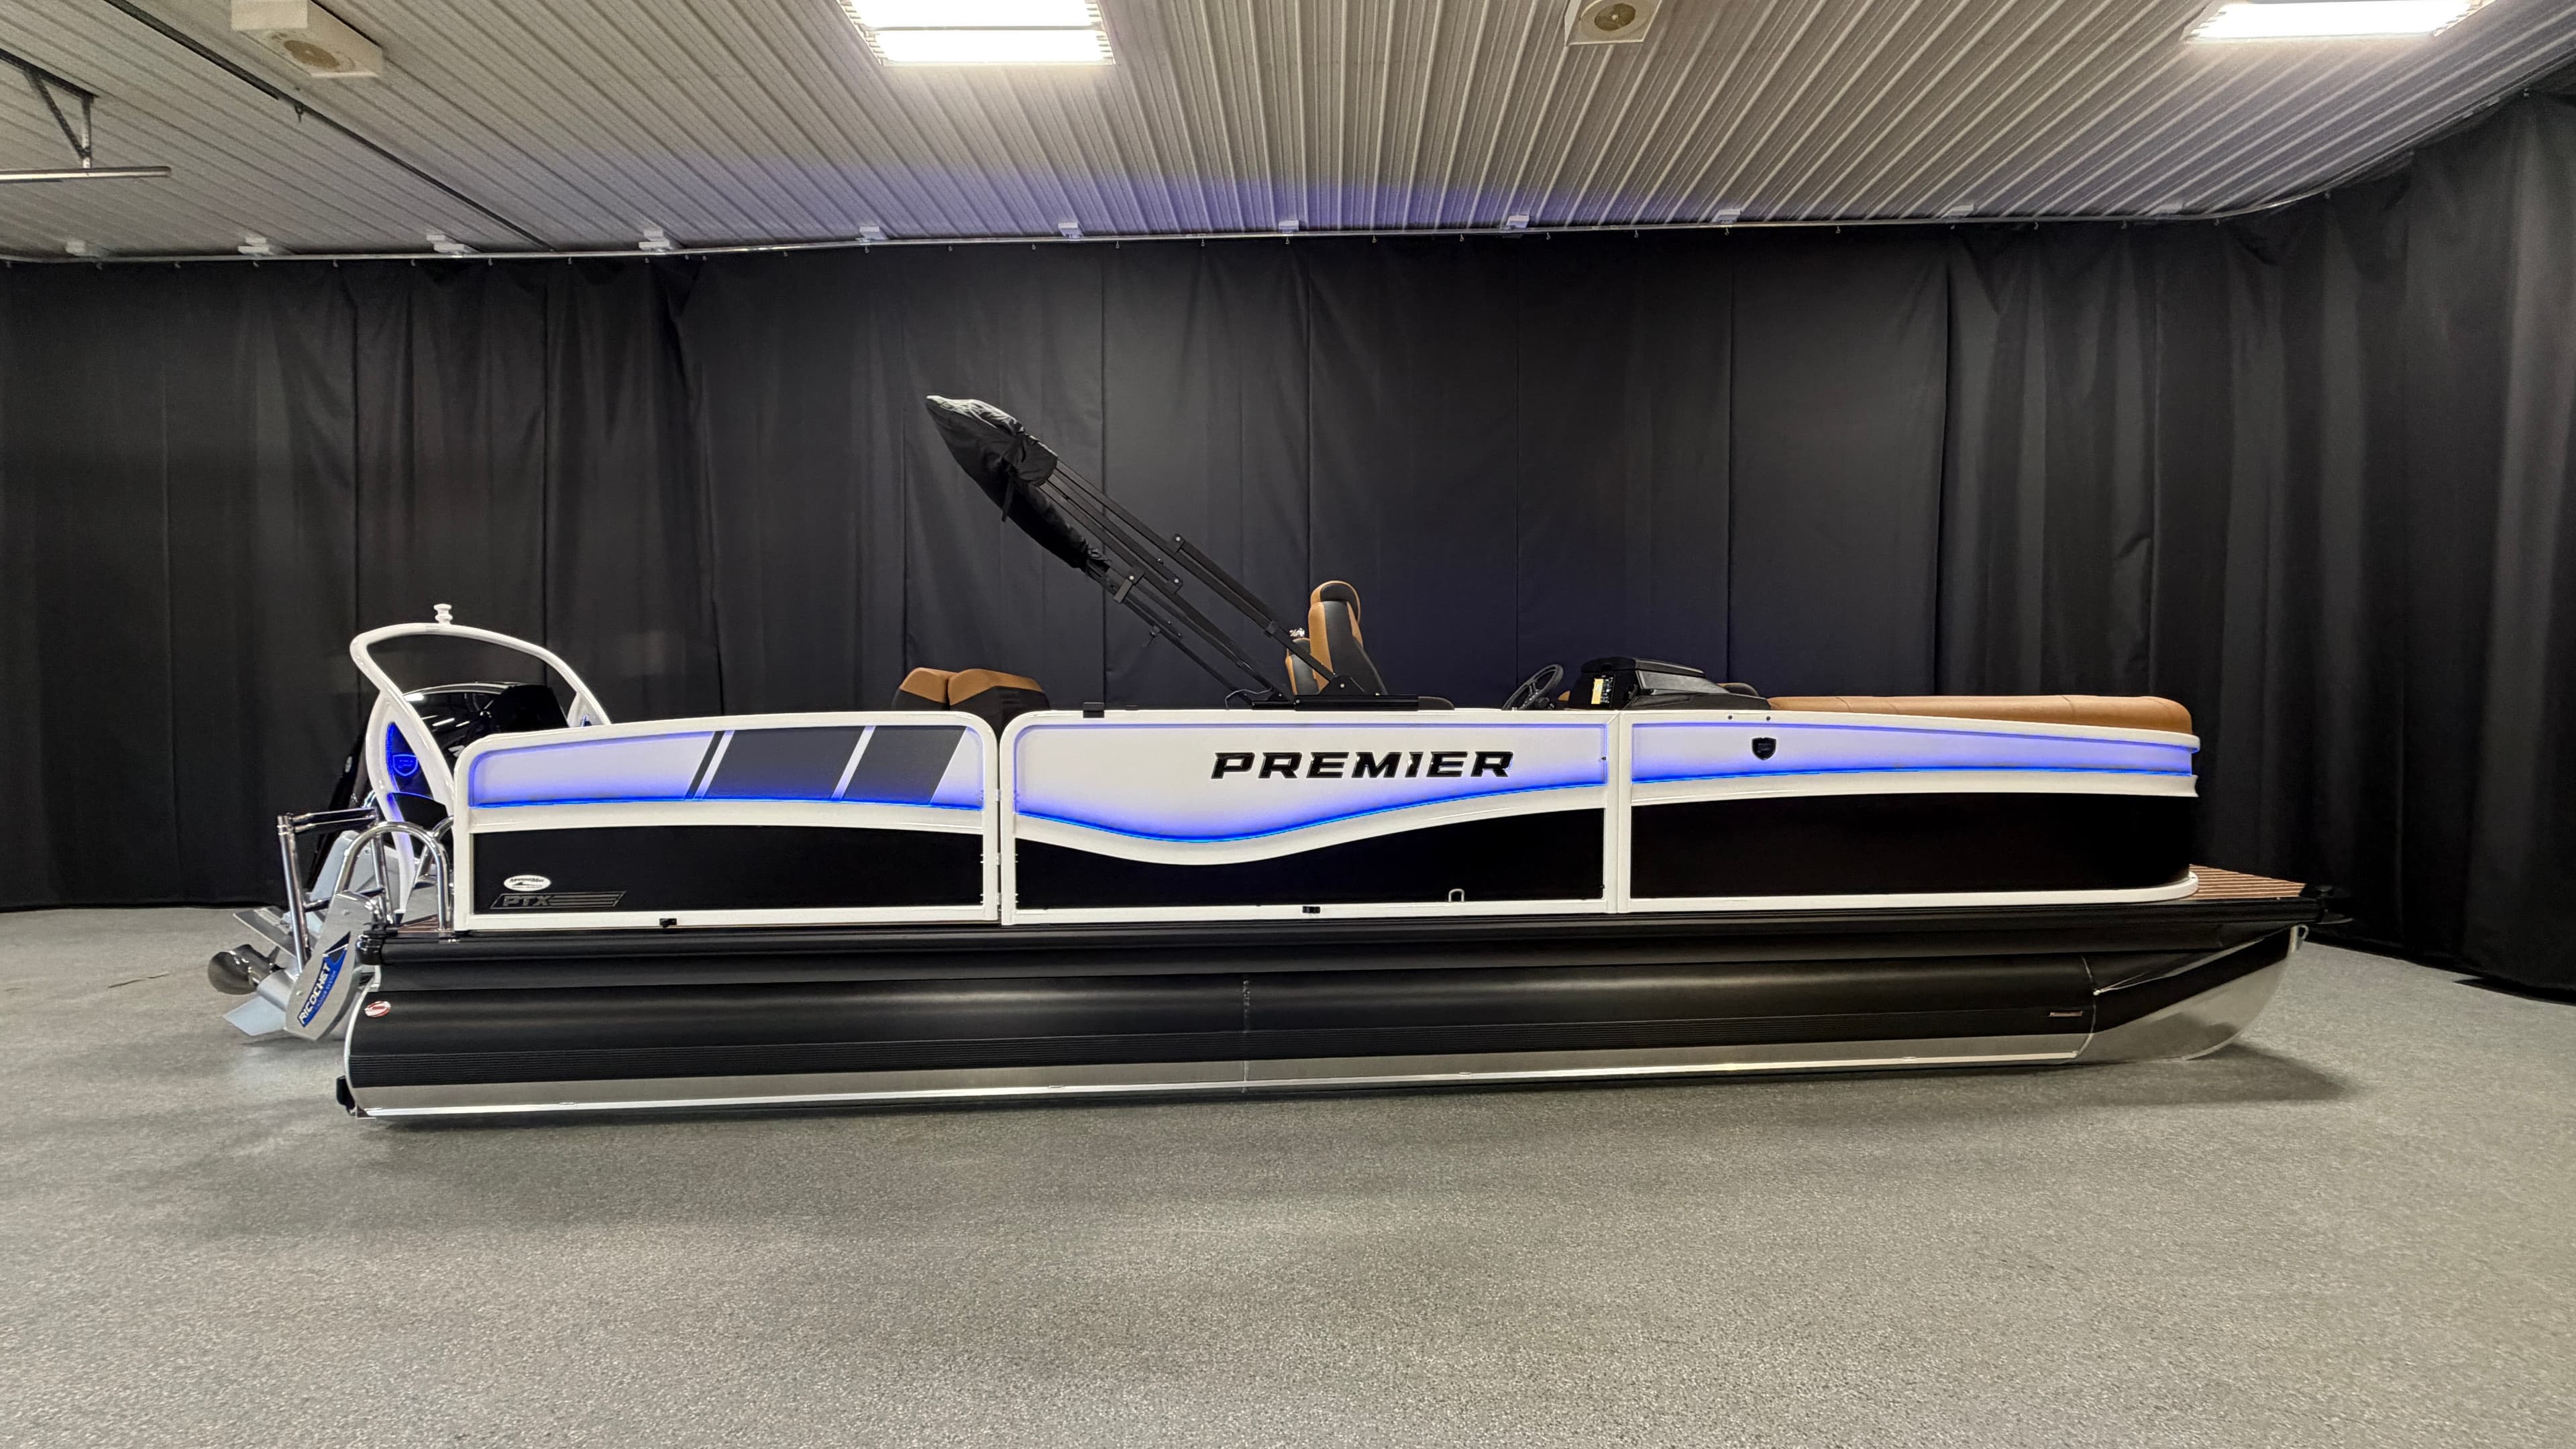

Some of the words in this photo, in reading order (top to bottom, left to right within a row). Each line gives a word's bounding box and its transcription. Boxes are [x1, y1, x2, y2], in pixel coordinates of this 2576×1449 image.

[1211, 751, 1513, 779] PREMIER
[503, 896, 552, 906] PTX
[299, 962, 330, 1024] RICOCHET
